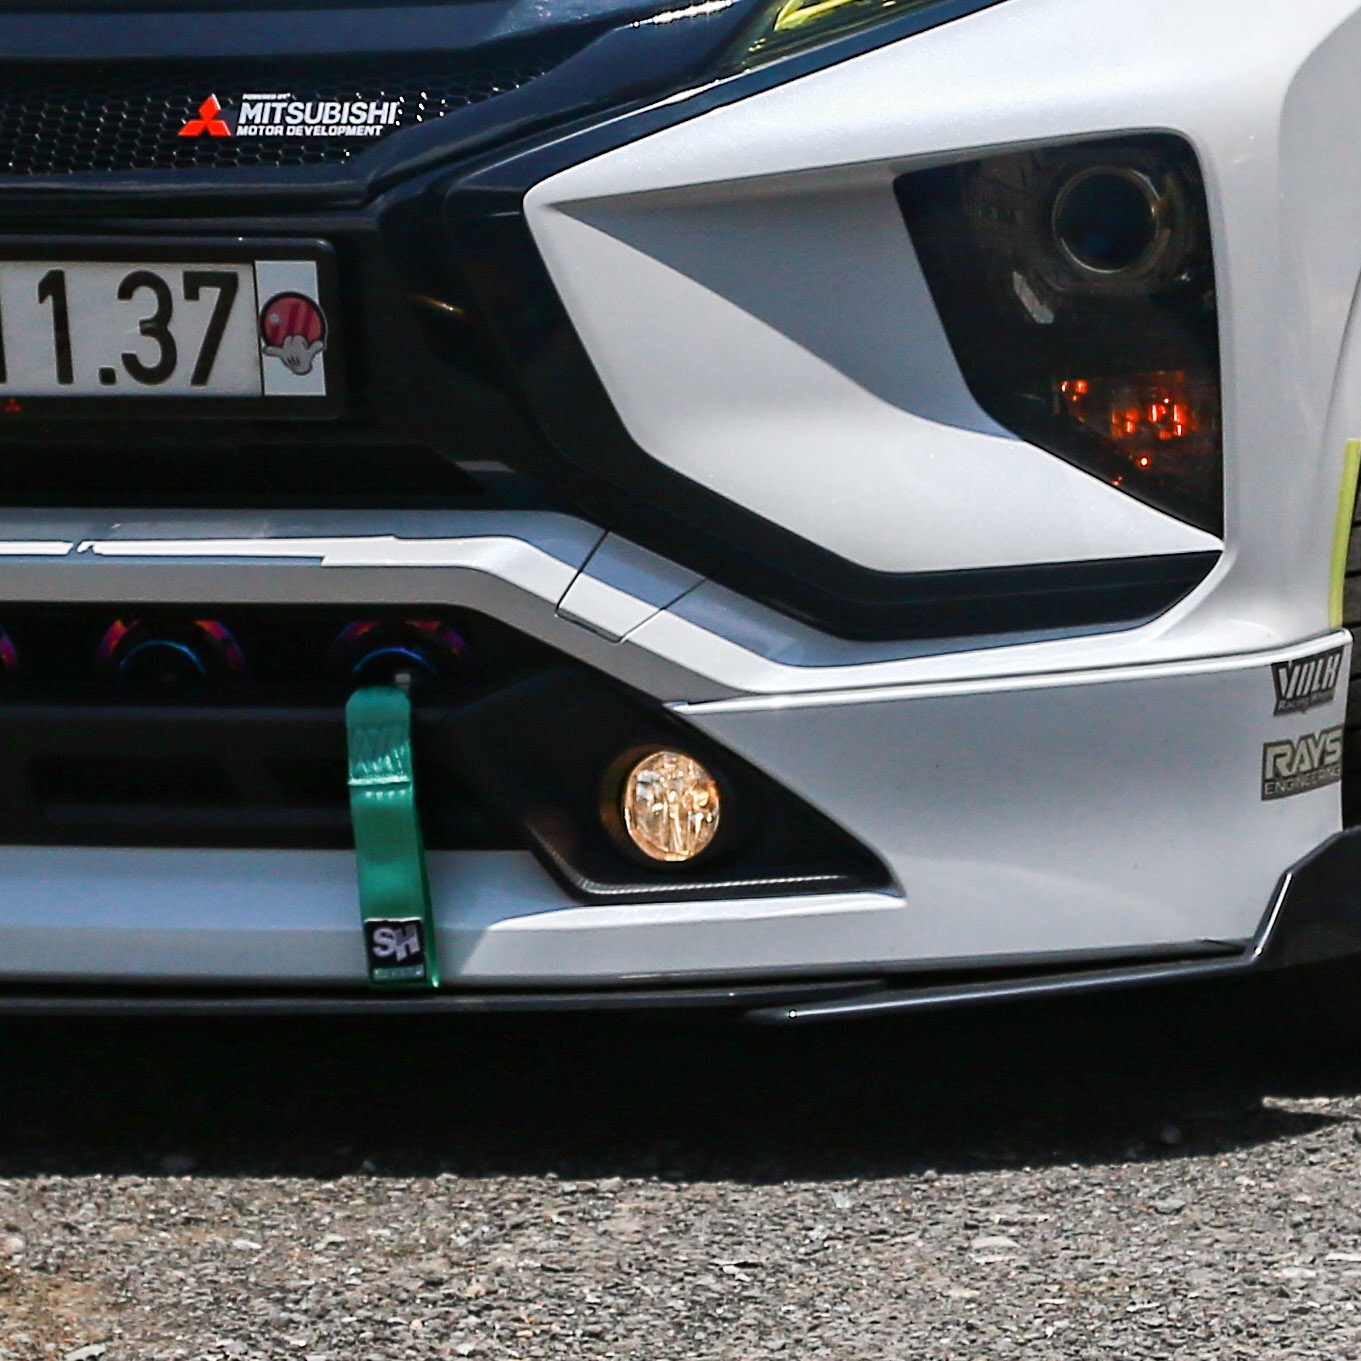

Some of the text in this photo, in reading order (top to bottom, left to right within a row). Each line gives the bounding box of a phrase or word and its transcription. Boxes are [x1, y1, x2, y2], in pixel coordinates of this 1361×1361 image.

[239, 102, 397, 125] MITSUBISHI
[236, 125, 384, 137] MOTOR DEVELOPMENT
[1265, 729, 1343, 780] RAYS
